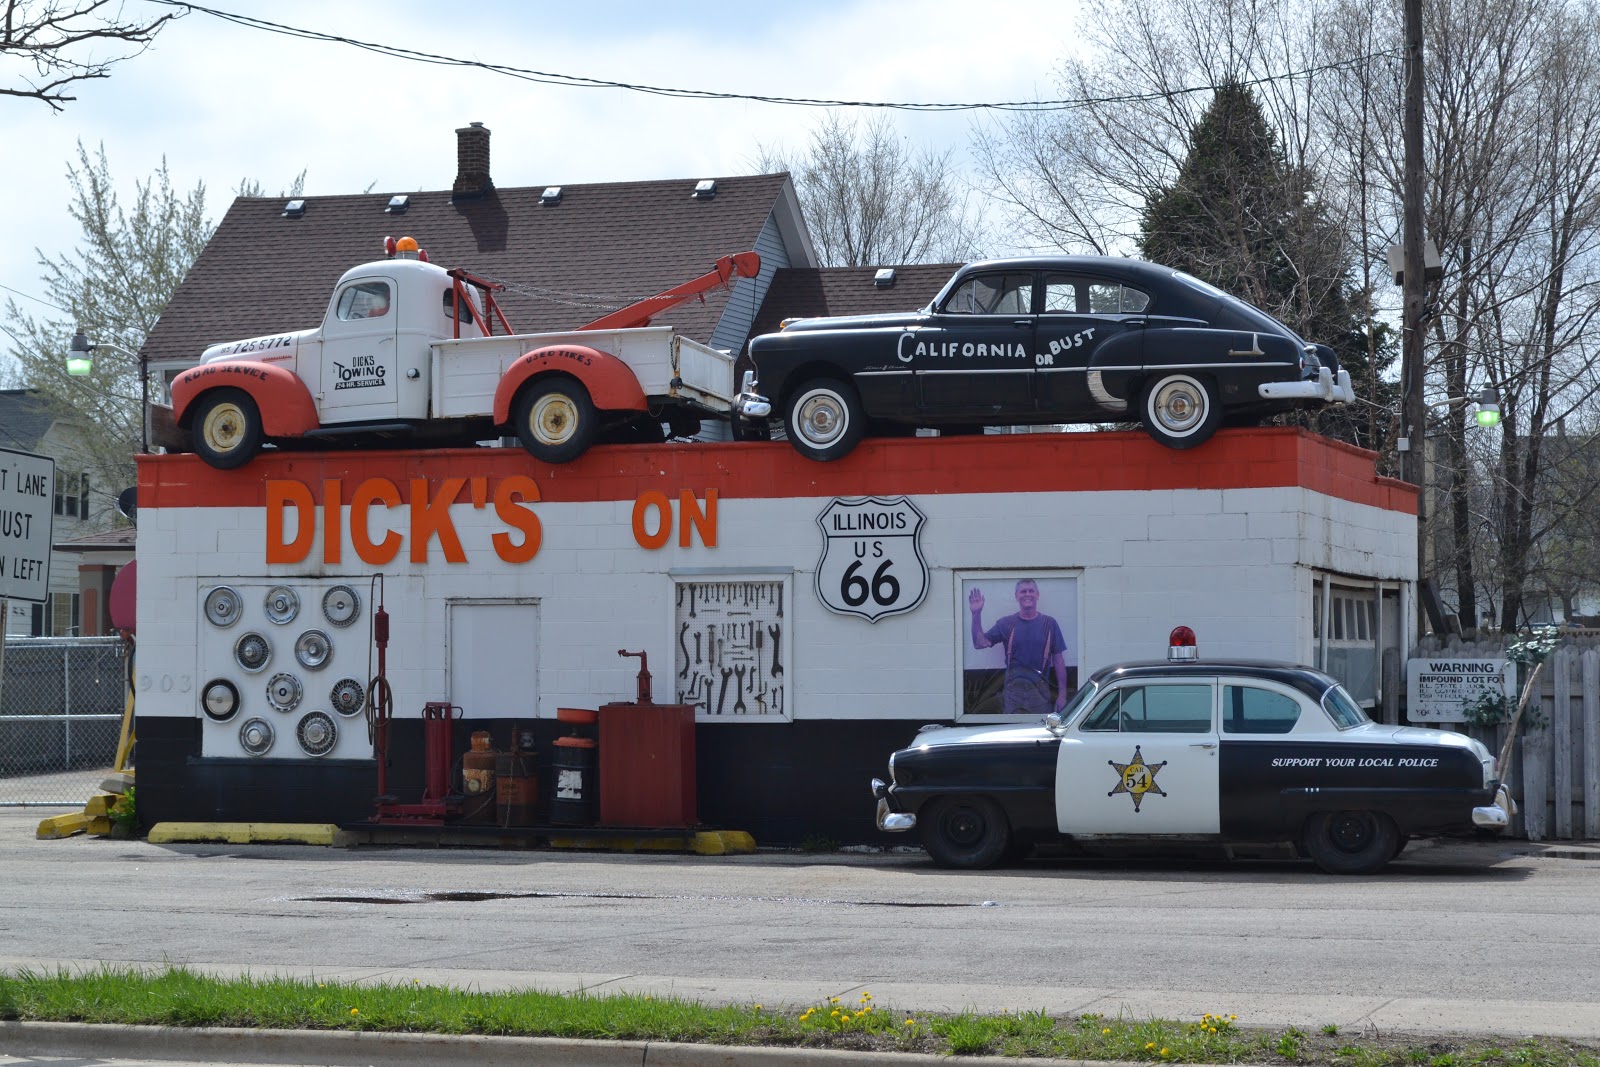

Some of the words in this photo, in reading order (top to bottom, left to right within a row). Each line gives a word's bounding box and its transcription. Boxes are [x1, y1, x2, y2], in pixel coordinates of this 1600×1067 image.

[897, 332, 1027, 363] CALIFORNIA
[1048, 327, 1096, 356] BUST
[352, 355, 375, 367] DICK'S
[526, 350, 555, 364] USED
[558, 350, 593, 366] TIRES
[184, 366, 217, 384] ROAD
[221, 365, 269, 381] SERVICE
[333, 361, 386, 381] TOWING
[357, 379, 383, 387] SERVICE
[17, 472, 47, 497] LANE
[0, 510, 32, 540] UST
[265, 475, 543, 565] DICK'S
[631, 487, 719, 551] ON
[833, 512, 907, 530] ILLINOIS
[13, 557, 43, 582] LEFT
[840, 559, 900, 607] 66
[1430, 663, 1494, 673] WARNING
[1271, 758, 1322, 767] SUPPORT
[1325, 758, 1355, 767] YOUR
[1358, 758, 1394, 767] LOCAL
[1397, 758, 1439, 767] POLICE
[1126, 773, 1148, 788] 54
